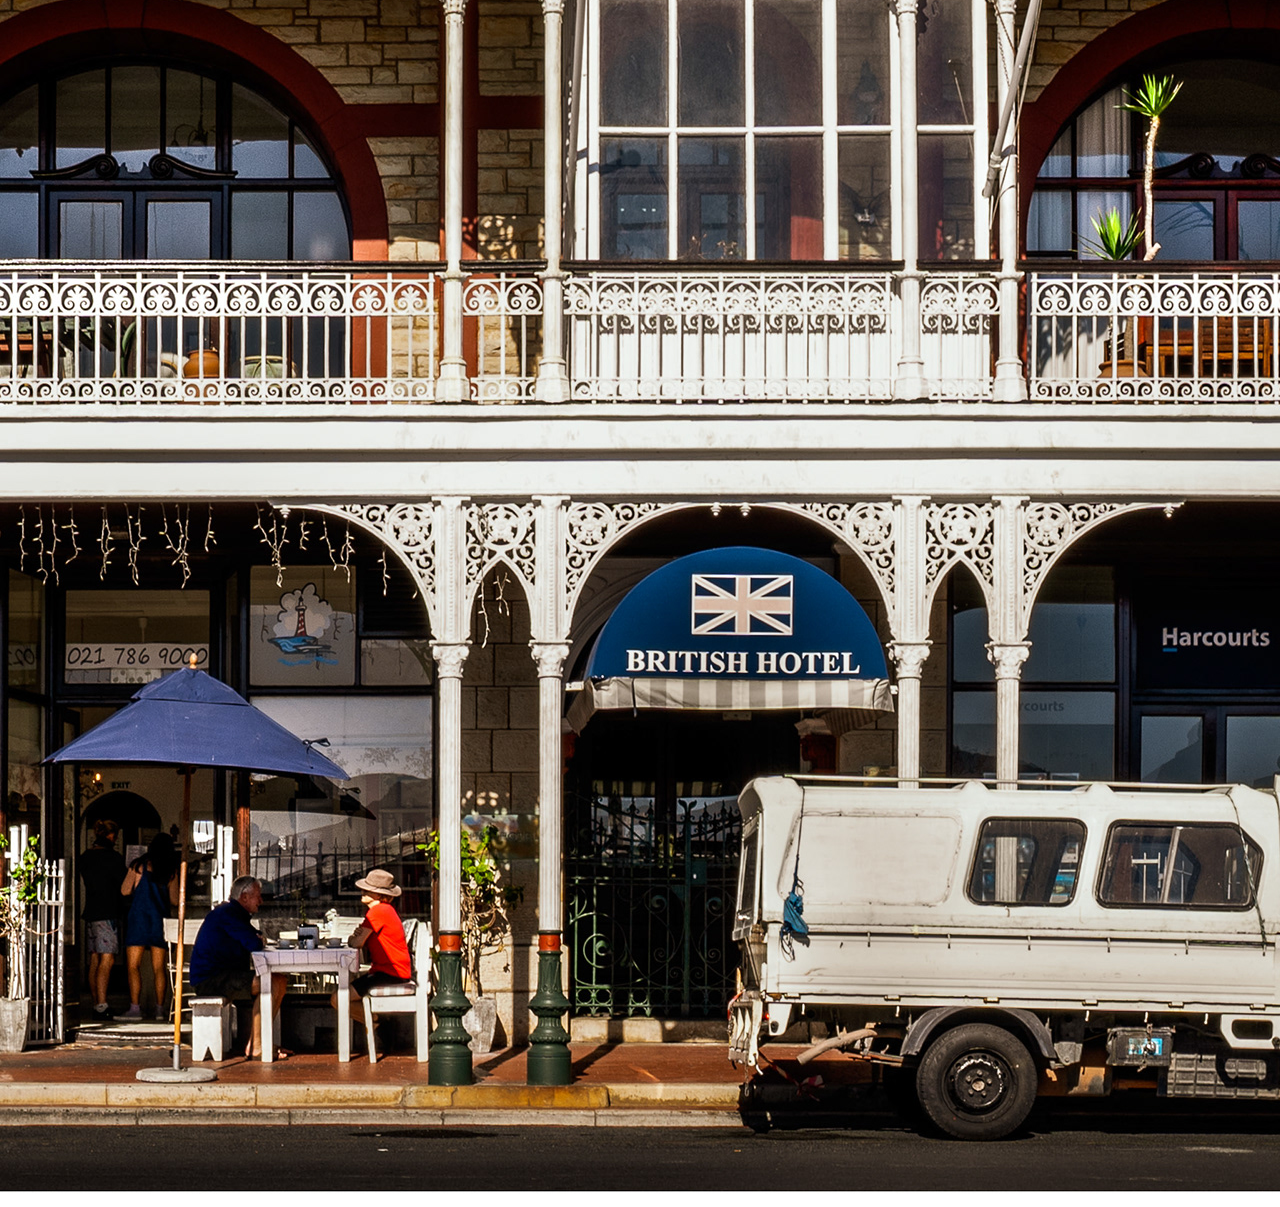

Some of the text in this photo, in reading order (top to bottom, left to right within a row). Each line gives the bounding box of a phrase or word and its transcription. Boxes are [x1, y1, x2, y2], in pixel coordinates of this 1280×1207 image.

[1162, 627, 1270, 648] Harcourts
[67, 646, 208, 666] 021 786 9000
[626, 649, 861, 675] BRITISH HOTEL
[1022, 700, 1065, 712] courts
[111, 781, 131, 789] EXIT
